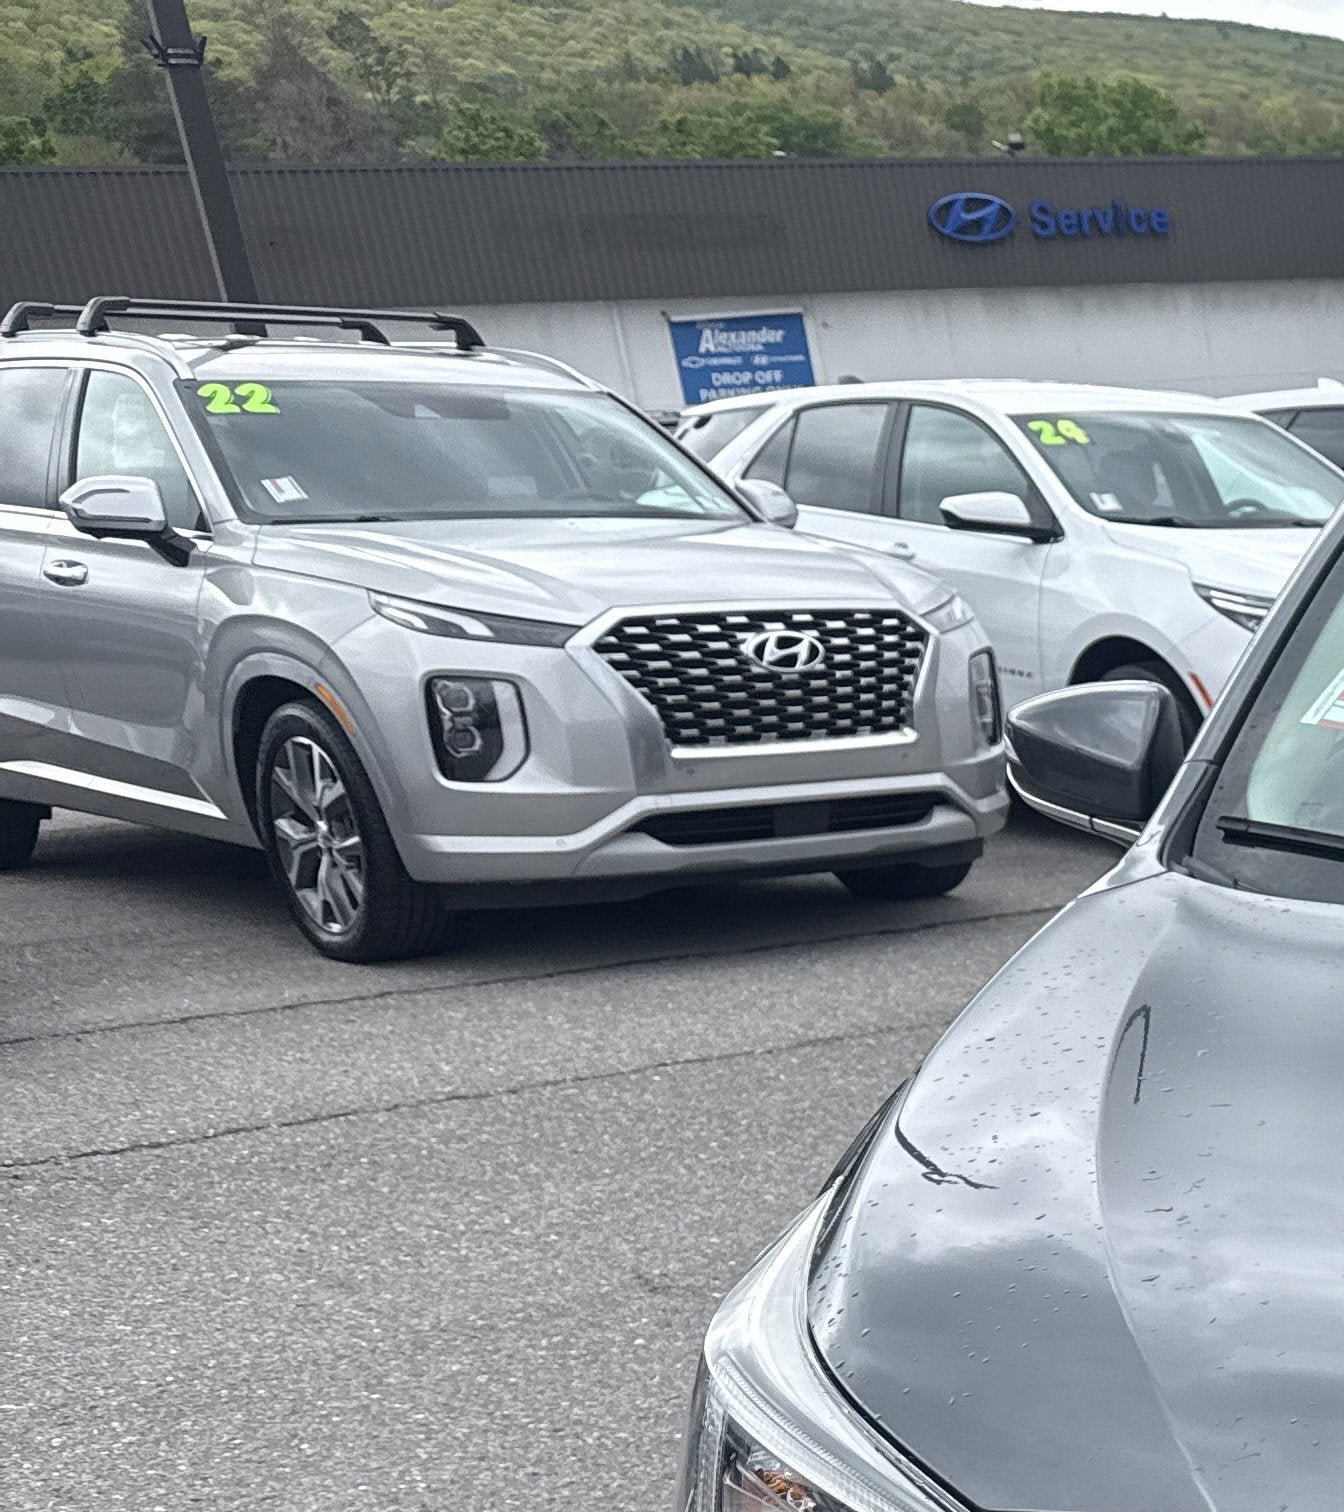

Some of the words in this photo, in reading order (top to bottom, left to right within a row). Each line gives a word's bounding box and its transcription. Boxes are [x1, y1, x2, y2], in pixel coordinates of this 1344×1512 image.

[1028, 198, 1170, 237] Service
[699, 326, 785, 353] Alexander
[711, 371, 752, 387] DROP
[754, 369, 783, 385] OFF
[197, 383, 280, 414] 22
